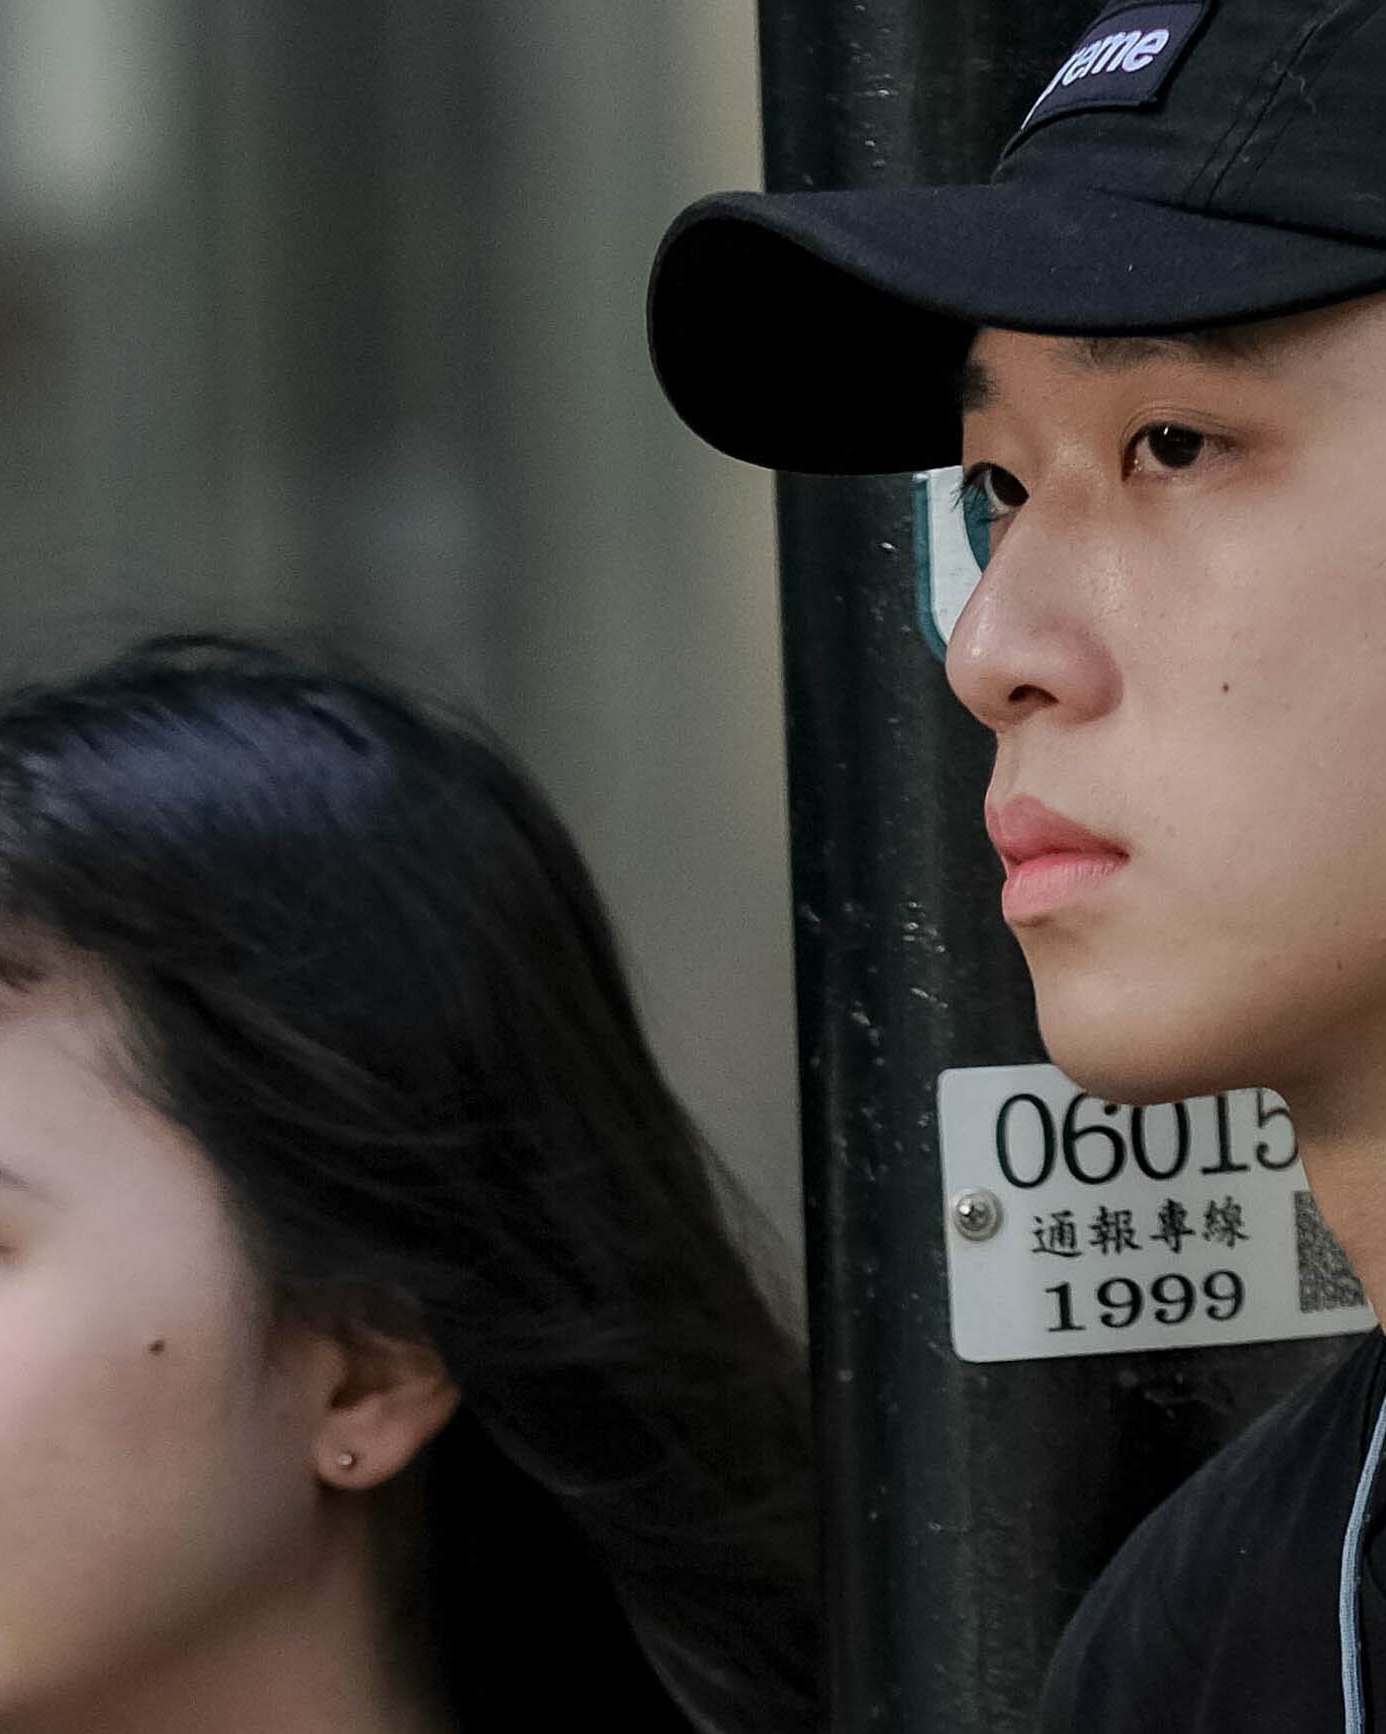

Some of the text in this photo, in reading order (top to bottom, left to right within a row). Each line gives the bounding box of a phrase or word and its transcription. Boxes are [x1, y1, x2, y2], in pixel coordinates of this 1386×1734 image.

[996, 1088, 1299, 1188] 06015
[1031, 1197, 1250, 1258] 通報專線
[1045, 1270, 1245, 1332] 1999
